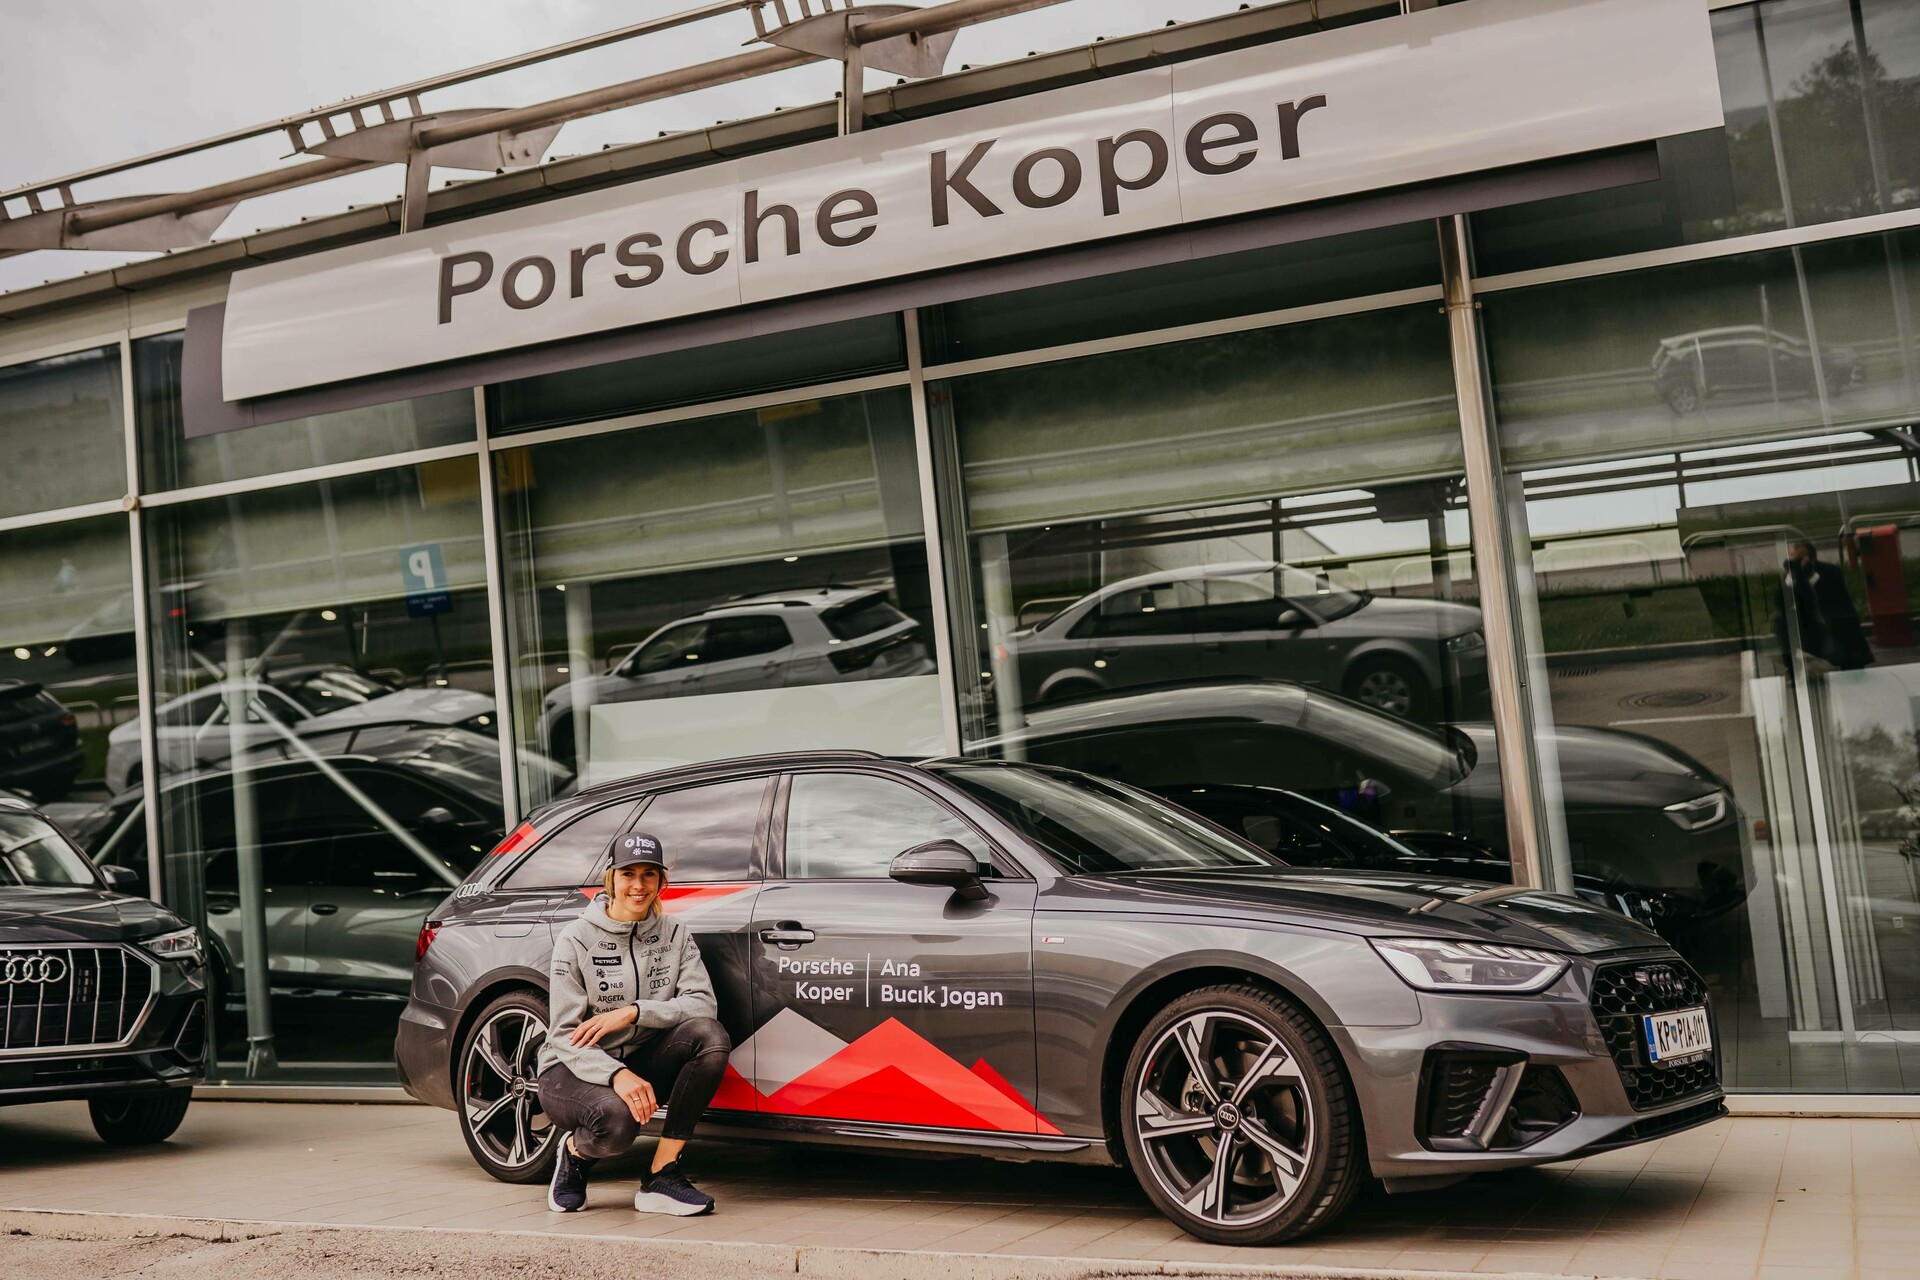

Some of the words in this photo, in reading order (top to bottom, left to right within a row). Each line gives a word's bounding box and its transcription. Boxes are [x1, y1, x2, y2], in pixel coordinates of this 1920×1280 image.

[436, 187, 879, 325] Porsche
[929, 93, 1328, 228] Koper
[636, 836, 655, 849] hse
[778, 956, 854, 976] Porsche
[880, 958, 921, 977] Ana
[597, 994, 625, 1003] ARGETA
[795, 981, 854, 1004] Koper
[940, 986, 1003, 1010] Jogan
[1656, 1020, 1670, 1052] KP
